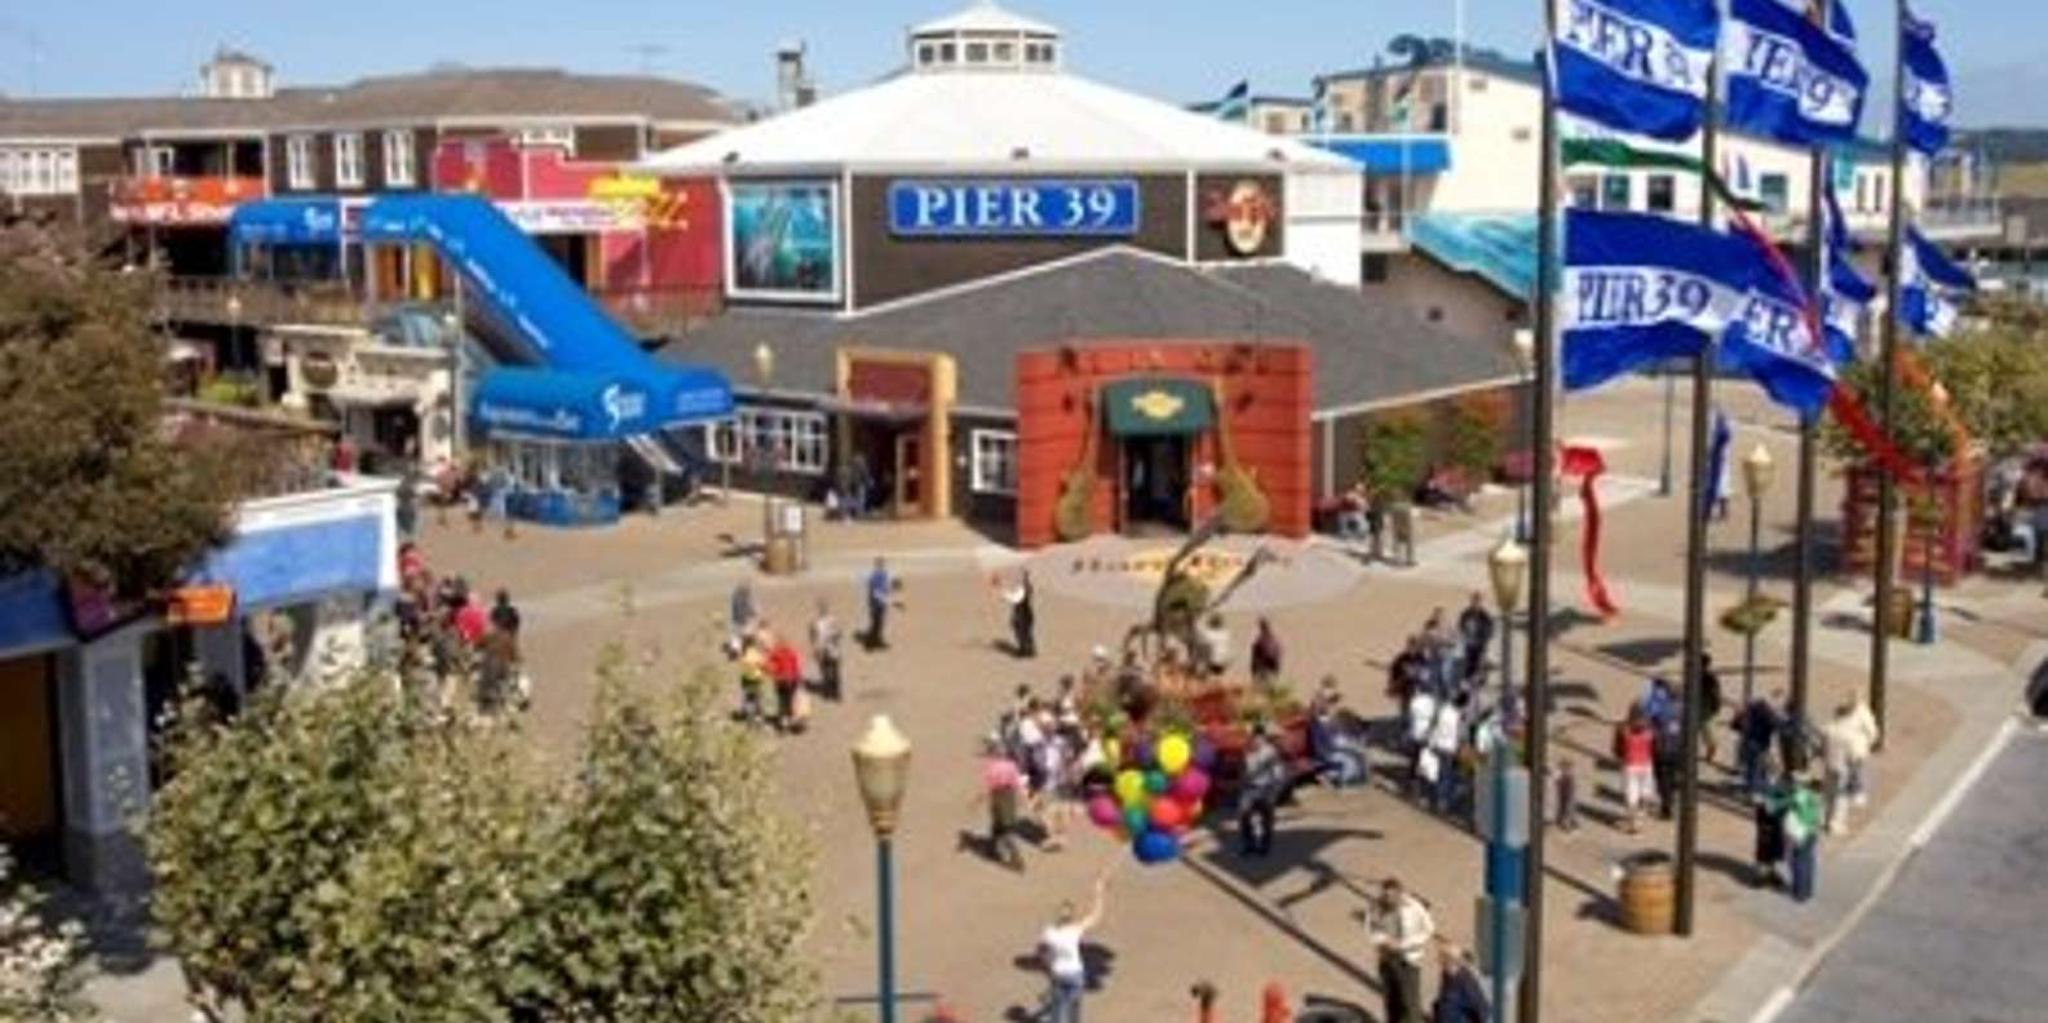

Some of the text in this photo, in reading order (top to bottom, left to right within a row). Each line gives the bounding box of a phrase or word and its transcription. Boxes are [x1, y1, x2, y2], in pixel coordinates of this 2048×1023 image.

[916, 186, 1117, 227] PIER 39
[1578, 272, 1712, 322] PIER 39
